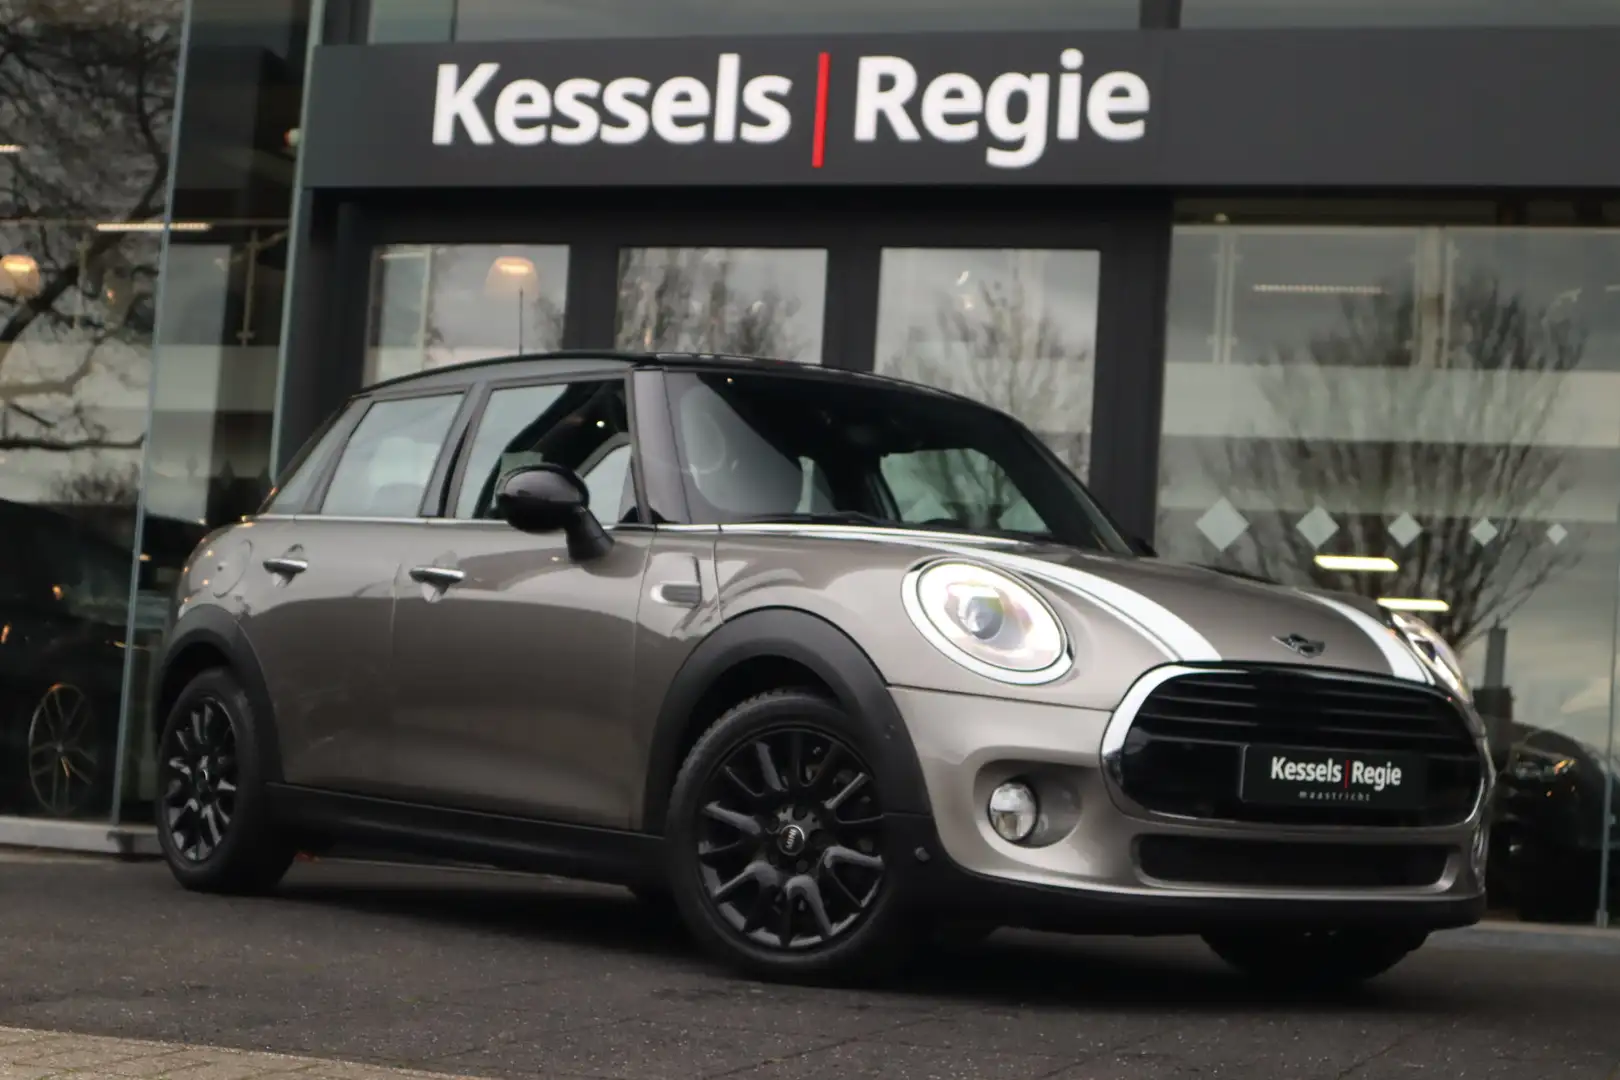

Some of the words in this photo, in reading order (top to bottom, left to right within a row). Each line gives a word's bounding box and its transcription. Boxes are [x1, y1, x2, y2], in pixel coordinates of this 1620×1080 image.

[432, 53, 793, 145] Kessels
[854, 48, 1150, 168] Regie
[1271, 756, 1342, 783] Kessels
[1351, 760, 1402, 791] Regie
